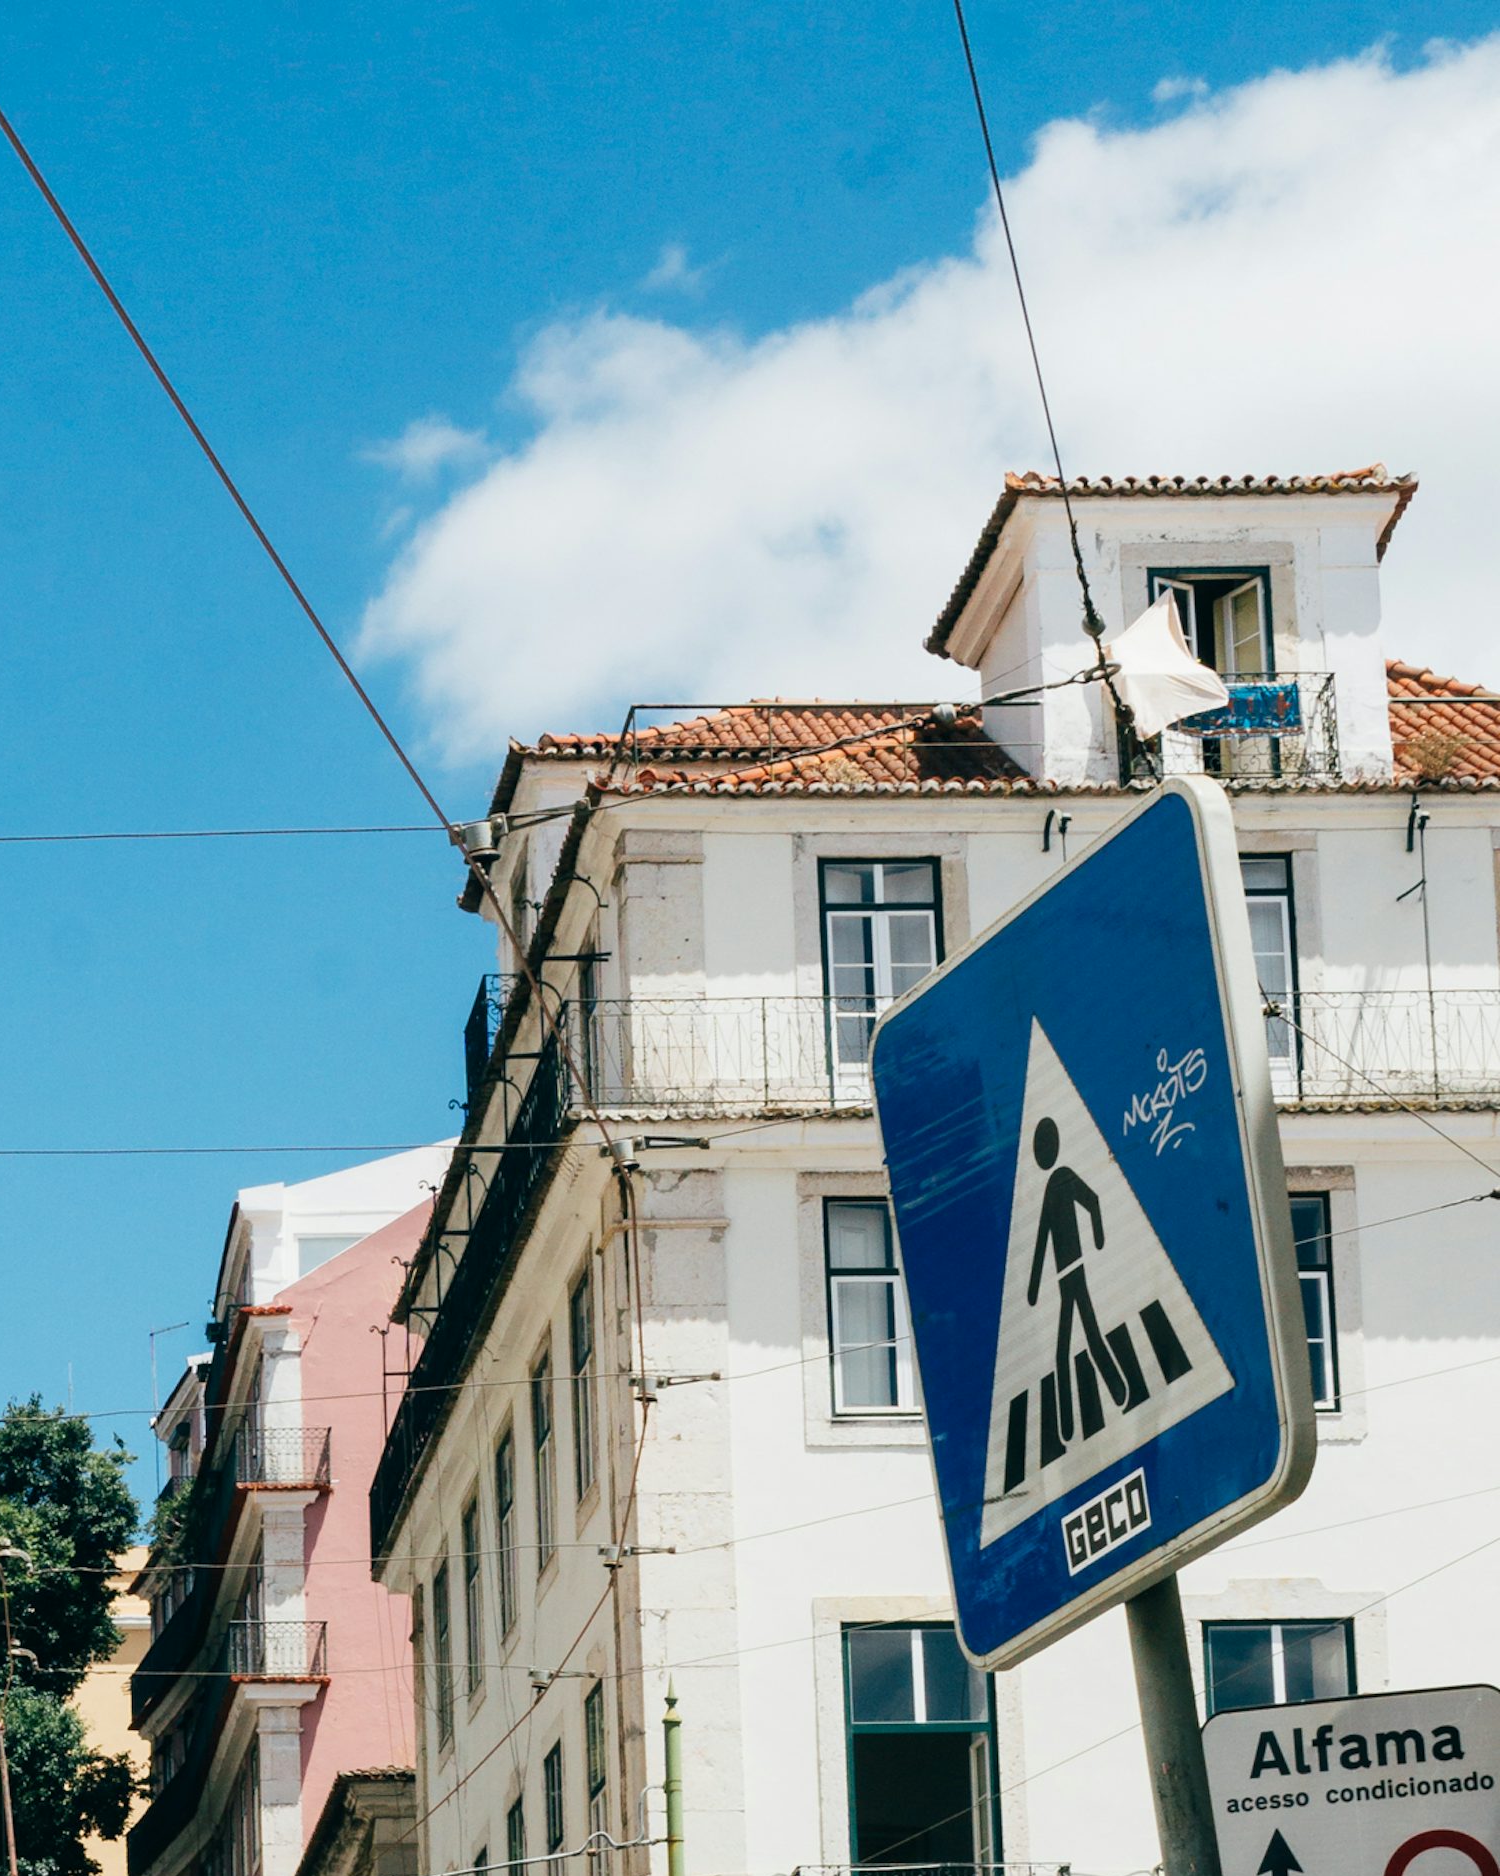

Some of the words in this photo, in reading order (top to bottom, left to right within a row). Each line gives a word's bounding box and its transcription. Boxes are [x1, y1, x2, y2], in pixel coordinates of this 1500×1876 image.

[1250, 1724, 1465, 1779] Alfama
[1226, 1790, 1310, 1813] acesso
[1325, 1771, 1495, 1804] condicionado
